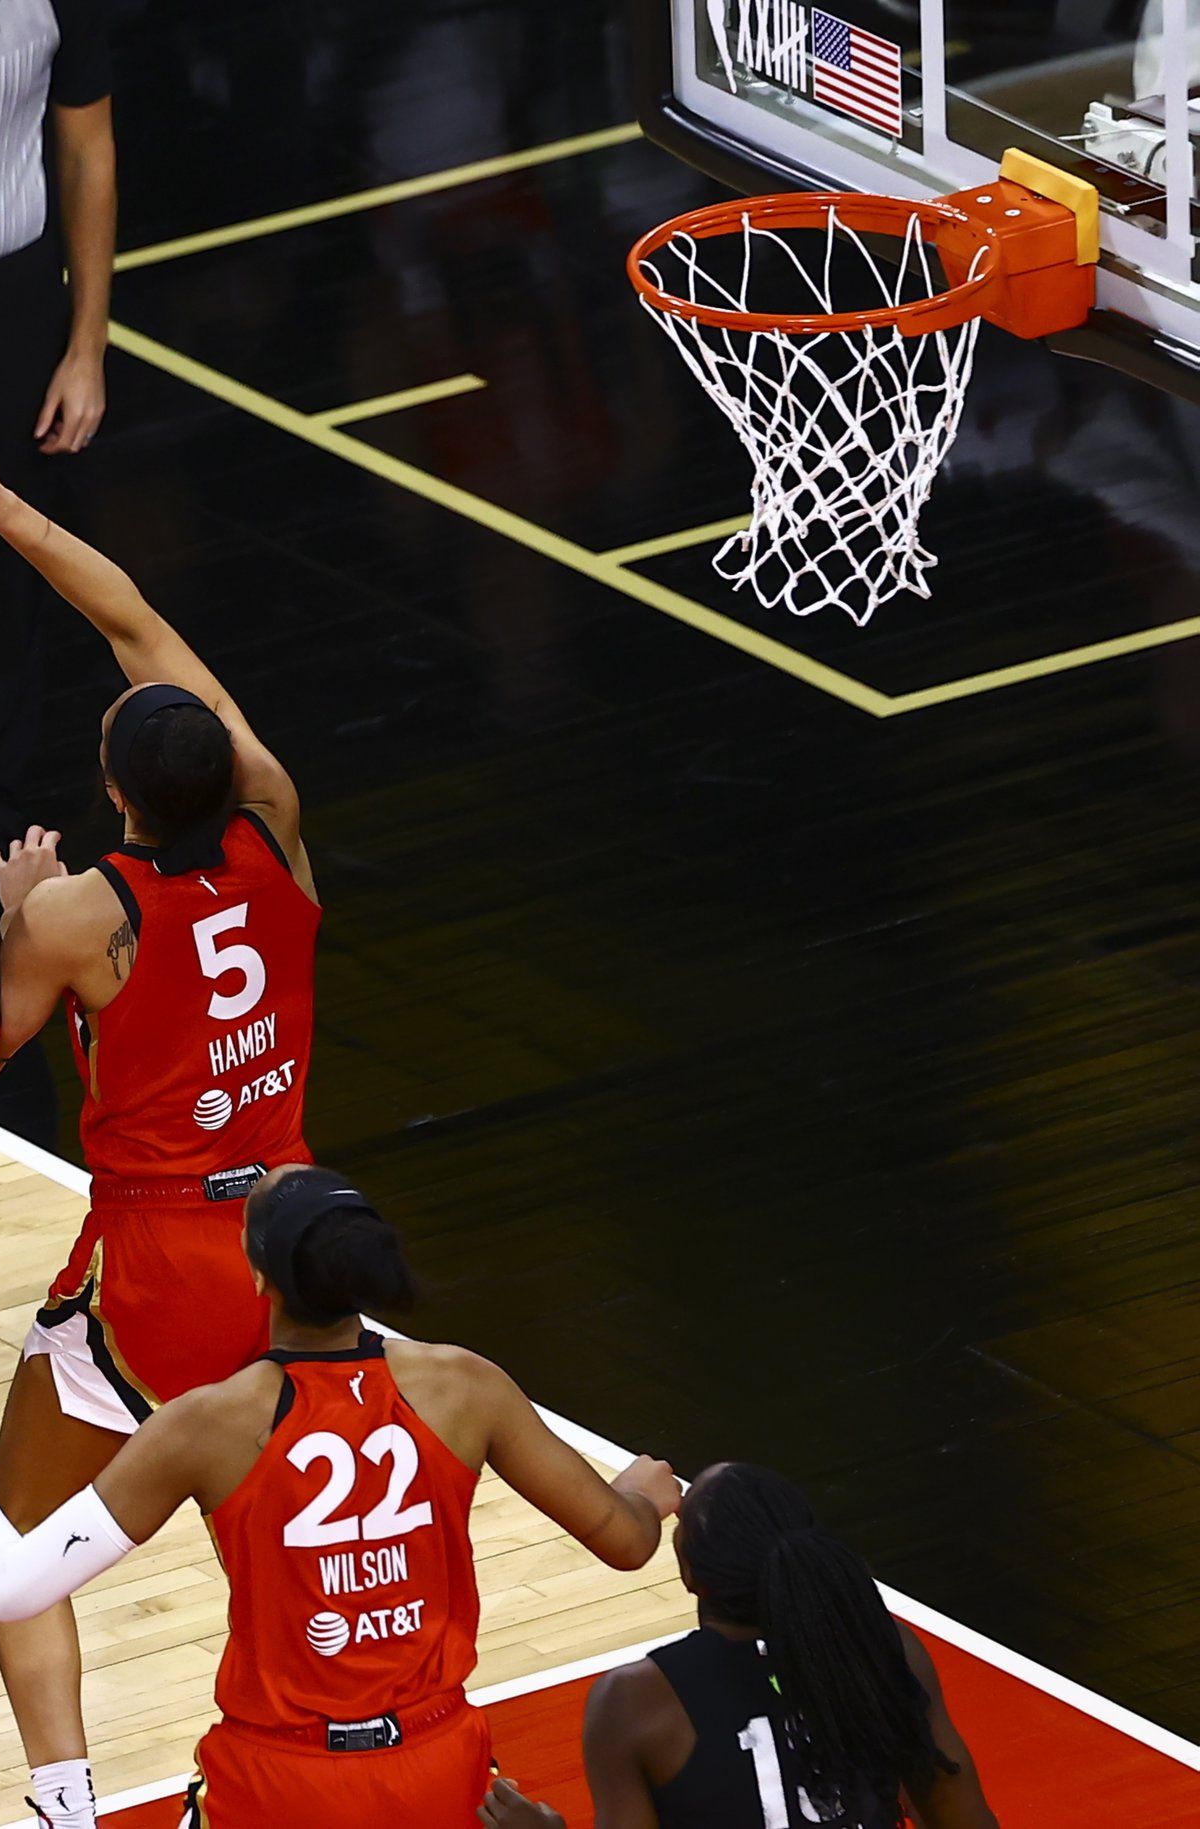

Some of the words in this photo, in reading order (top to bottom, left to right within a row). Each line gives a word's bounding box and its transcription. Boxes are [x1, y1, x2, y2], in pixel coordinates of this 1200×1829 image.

[192, 901, 266, 1020] 5
[208, 1012, 276, 1077] HAMBY
[237, 1059, 296, 1112] AT&T
[283, 1423, 433, 1548] 22
[319, 1543, 408, 1596] WILSON
[355, 1599, 425, 1644] AT&T
